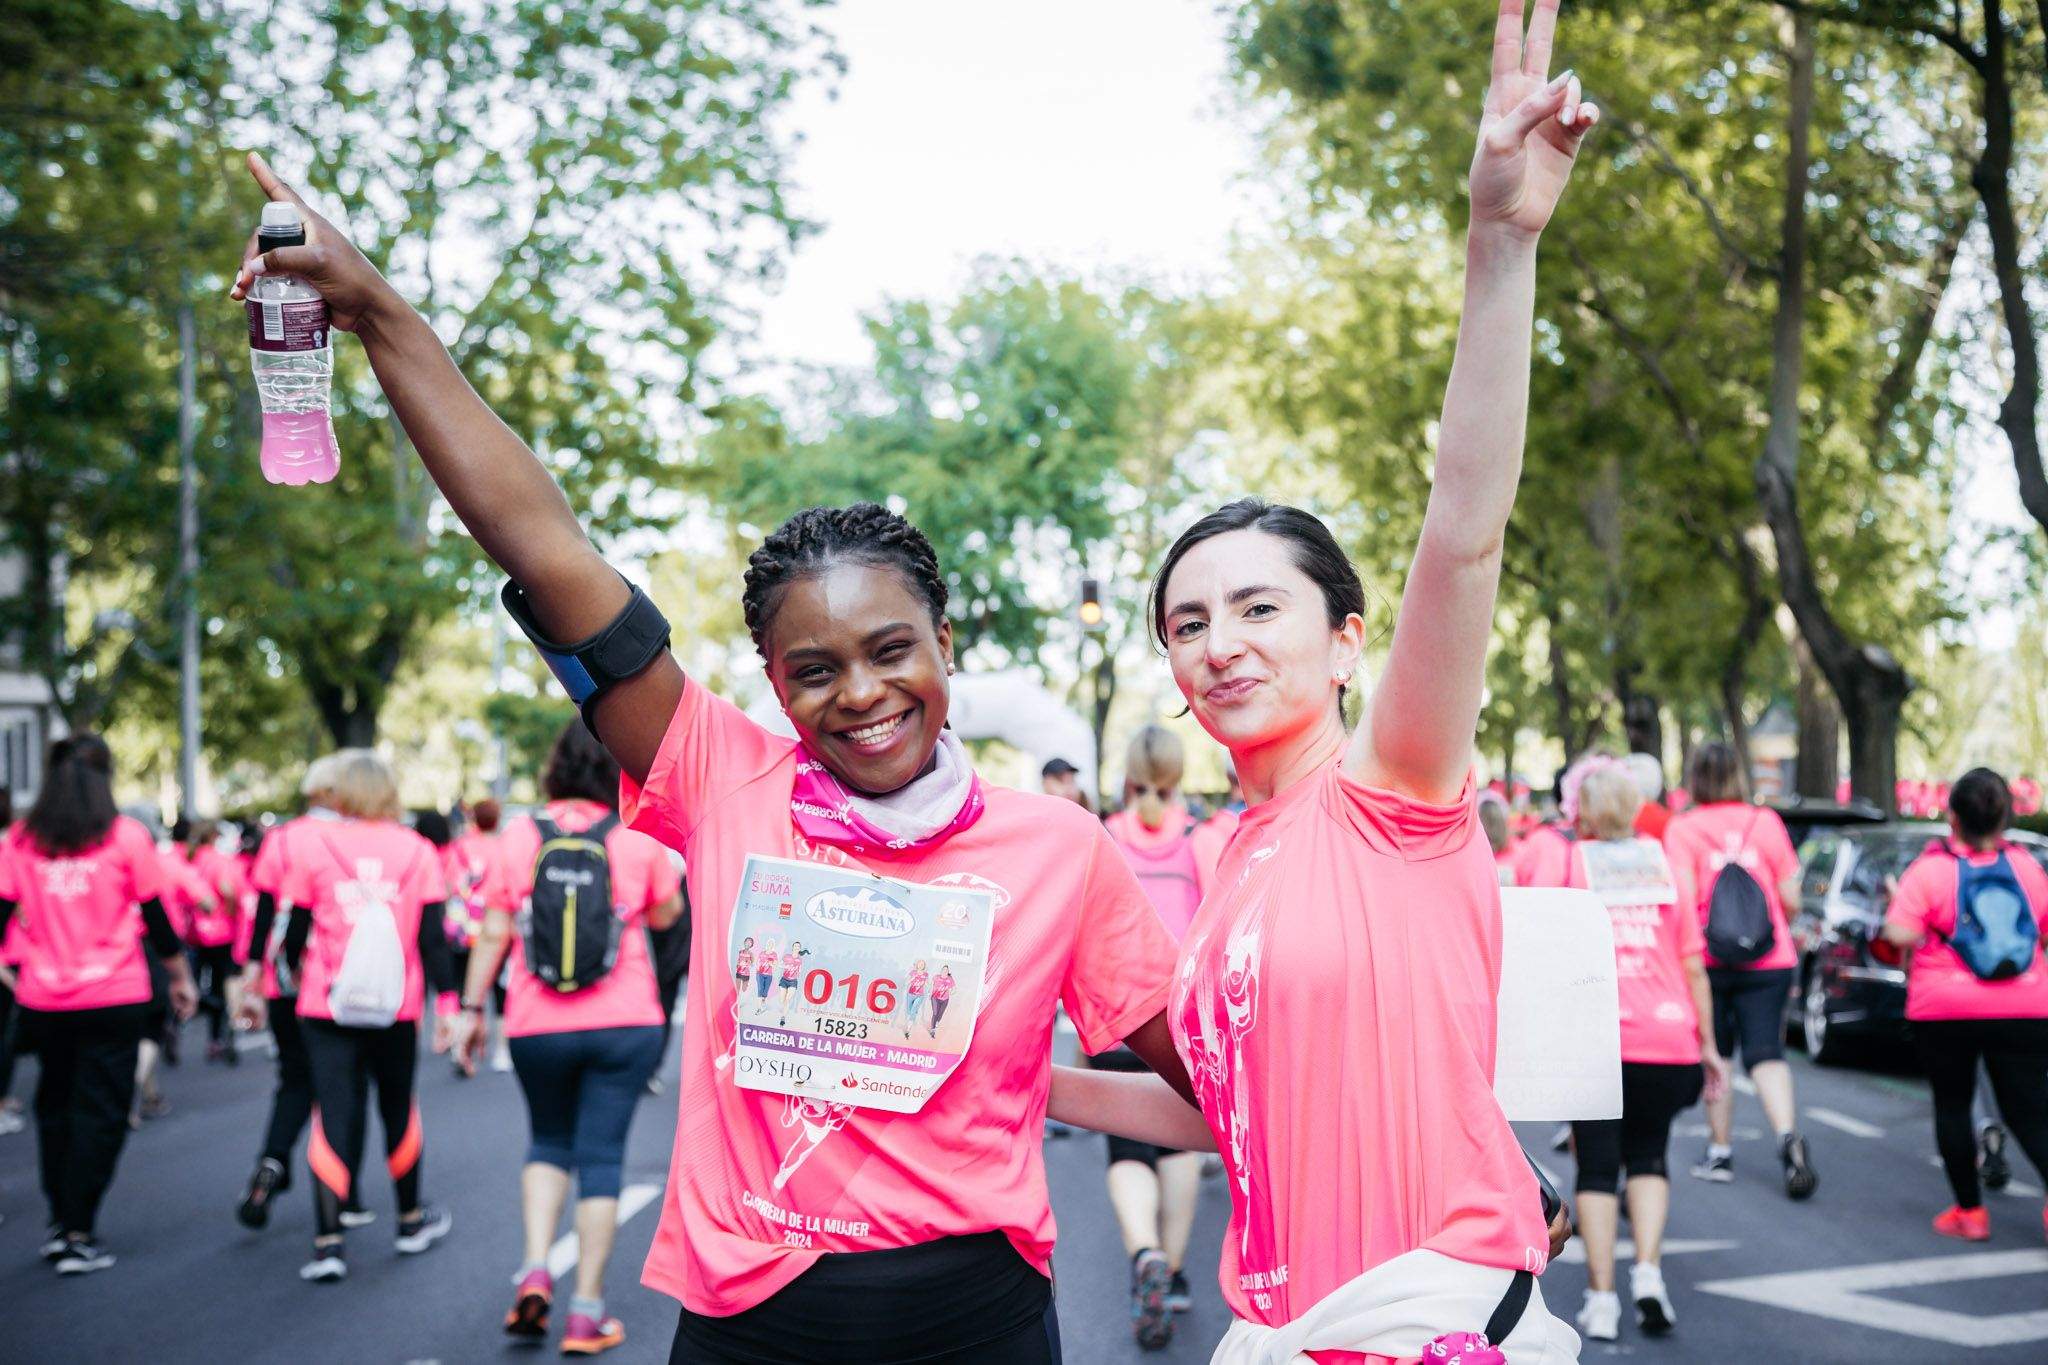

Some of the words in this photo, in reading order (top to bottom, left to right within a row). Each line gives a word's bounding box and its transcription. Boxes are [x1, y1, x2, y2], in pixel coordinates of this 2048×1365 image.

[751, 880, 791, 897] SUMA
[810, 898, 907, 932] ASTURIANA
[803, 969, 897, 1014] 016
[815, 1017, 868, 1039] 15823
[743, 1028, 795, 1048] CARRERA
[798, 1037, 814, 1050] DE
[816, 1040, 833, 1053] LA
[835, 1042, 877, 1060] MUJER
[886, 1050, 937, 1069] MADRID
[739, 1055, 812, 1081] OYSHO
[788, 1211, 804, 1230] DE
[806, 1215, 821, 1233] LA
[823, 1218, 869, 1238] MUJER
[784, 1230, 813, 1249] 2024
